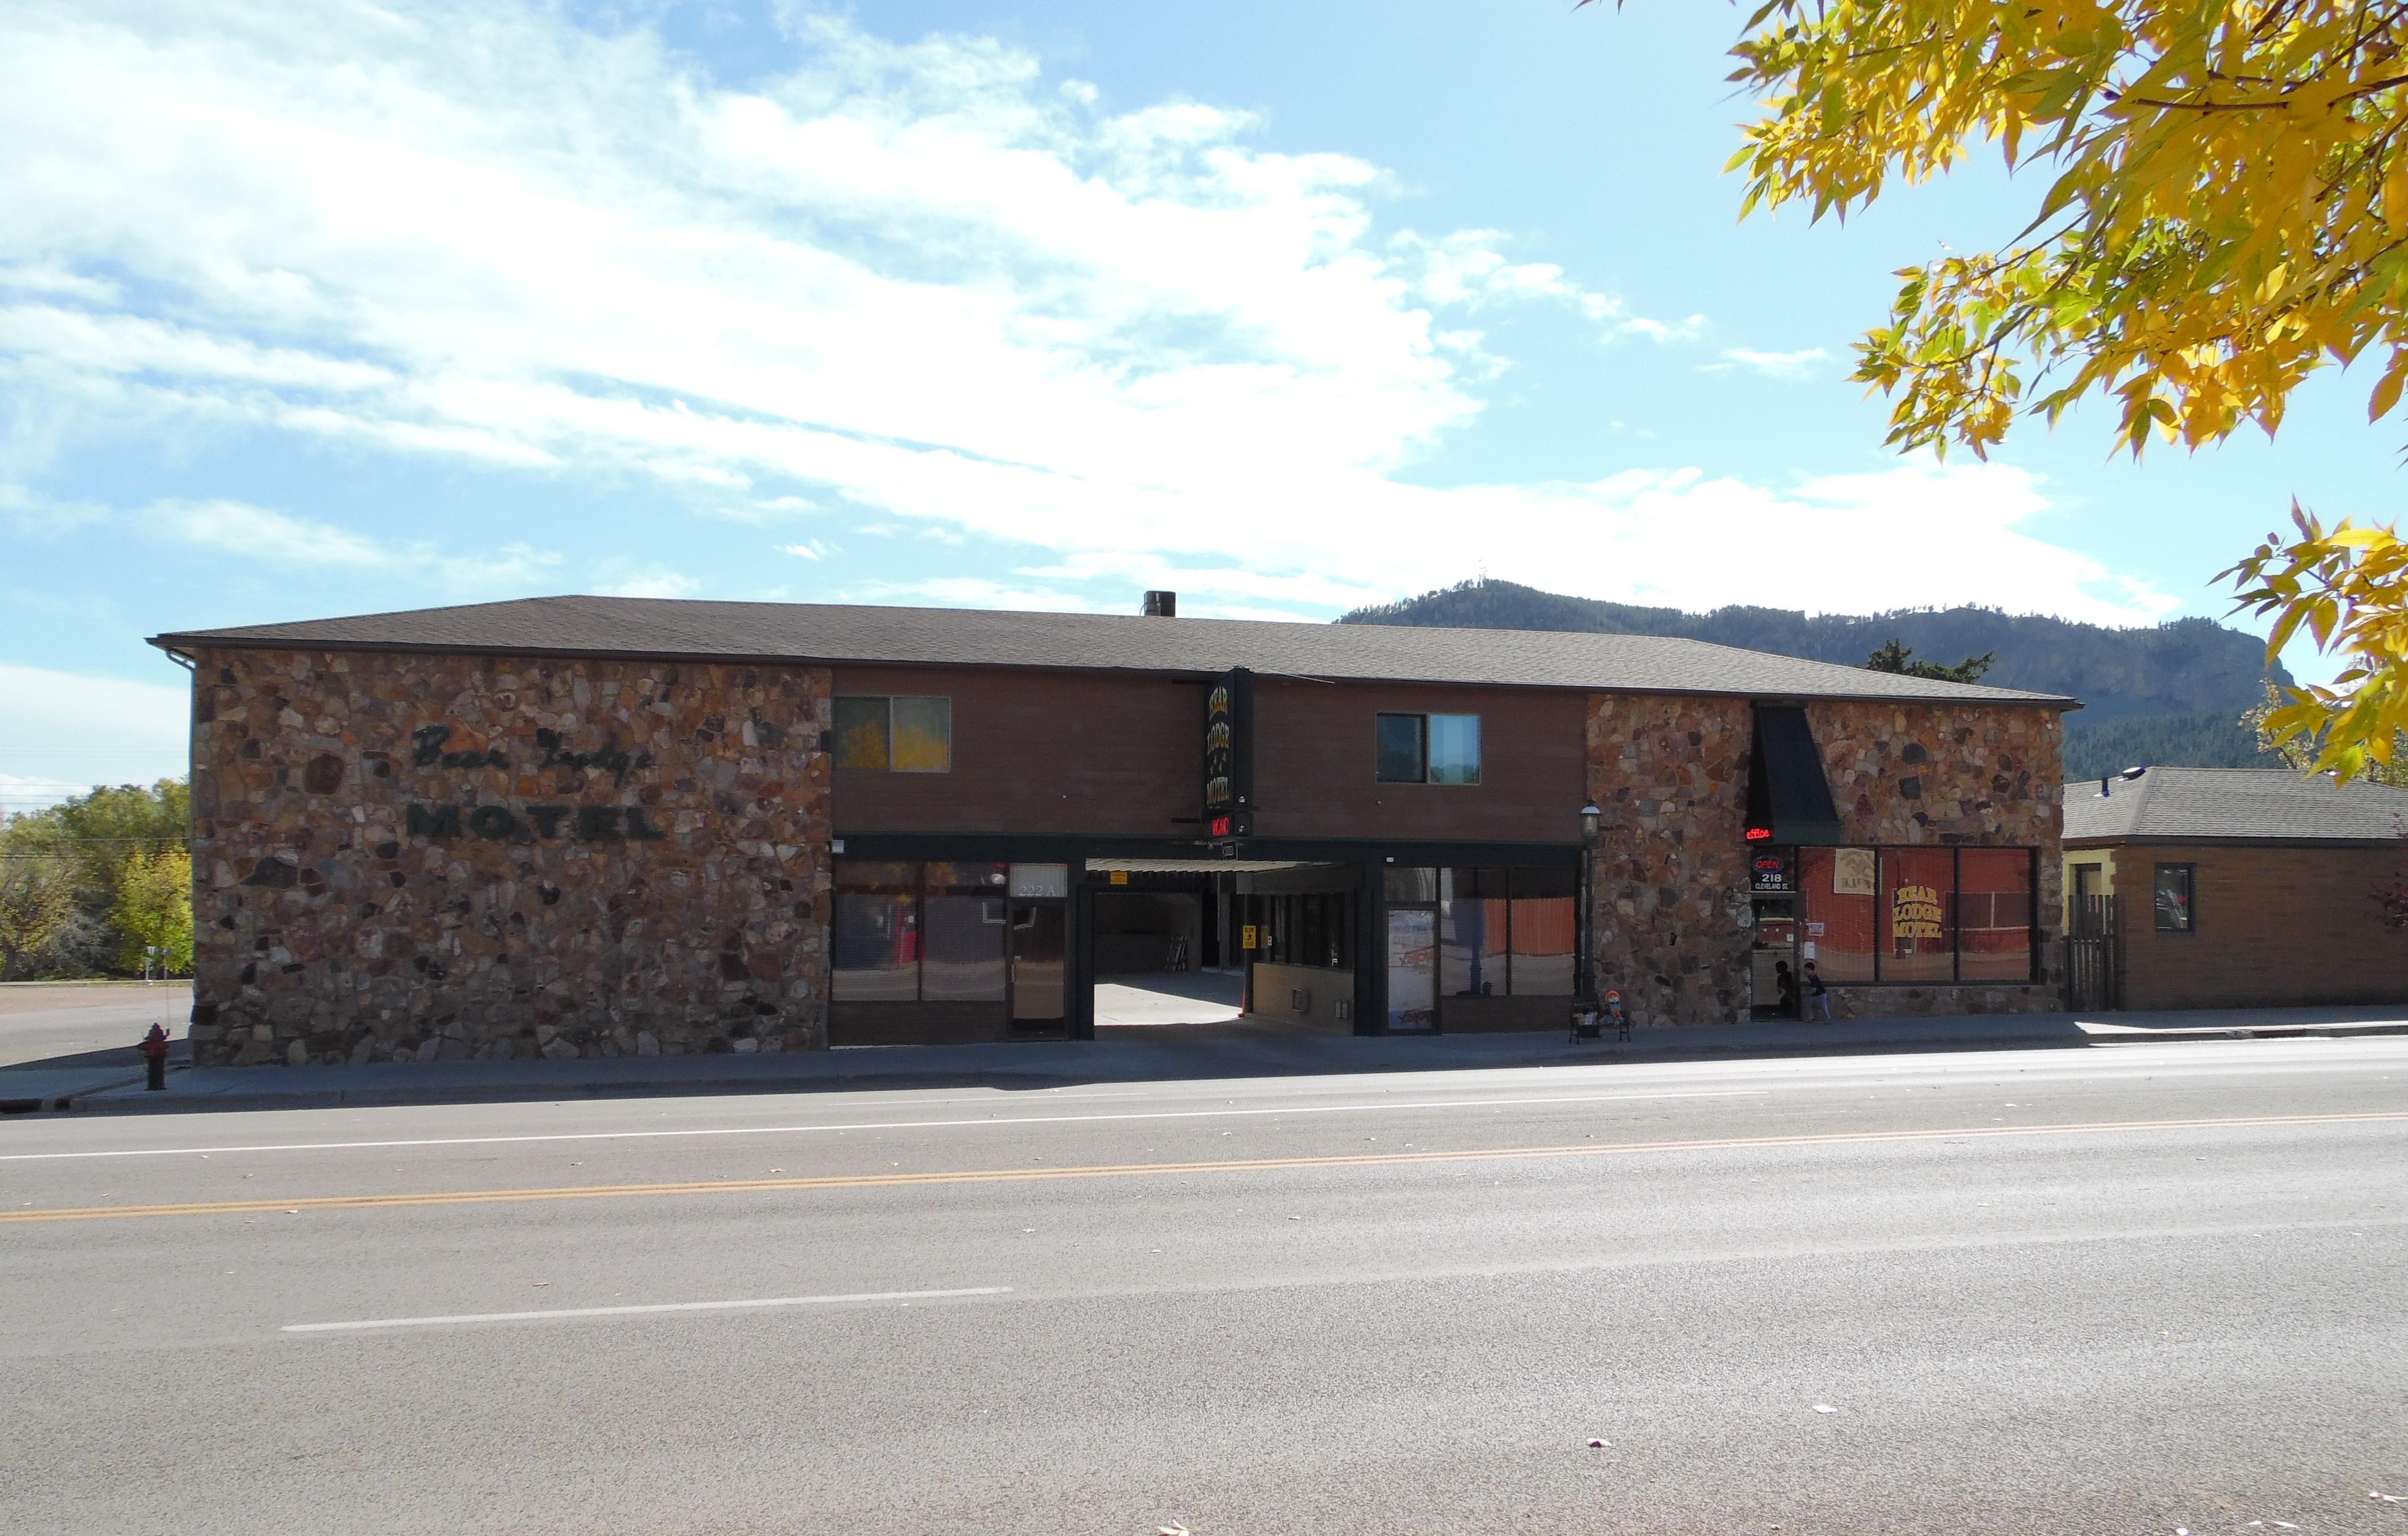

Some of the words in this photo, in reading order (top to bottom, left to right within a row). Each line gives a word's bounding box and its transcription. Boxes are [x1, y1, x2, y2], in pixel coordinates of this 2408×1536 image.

[407, 804, 665, 840] MOTEL
[1756, 860, 1779, 869] OPEN
[1762, 874, 1782, 882] 218
[1018, 885, 1043, 896] 222
[1047, 885, 1056, 896] A
[1897, 886, 1938, 904] BEAR
[1893, 904, 1942, 923] LODGE
[1893, 922, 1942, 938] MOTEL
